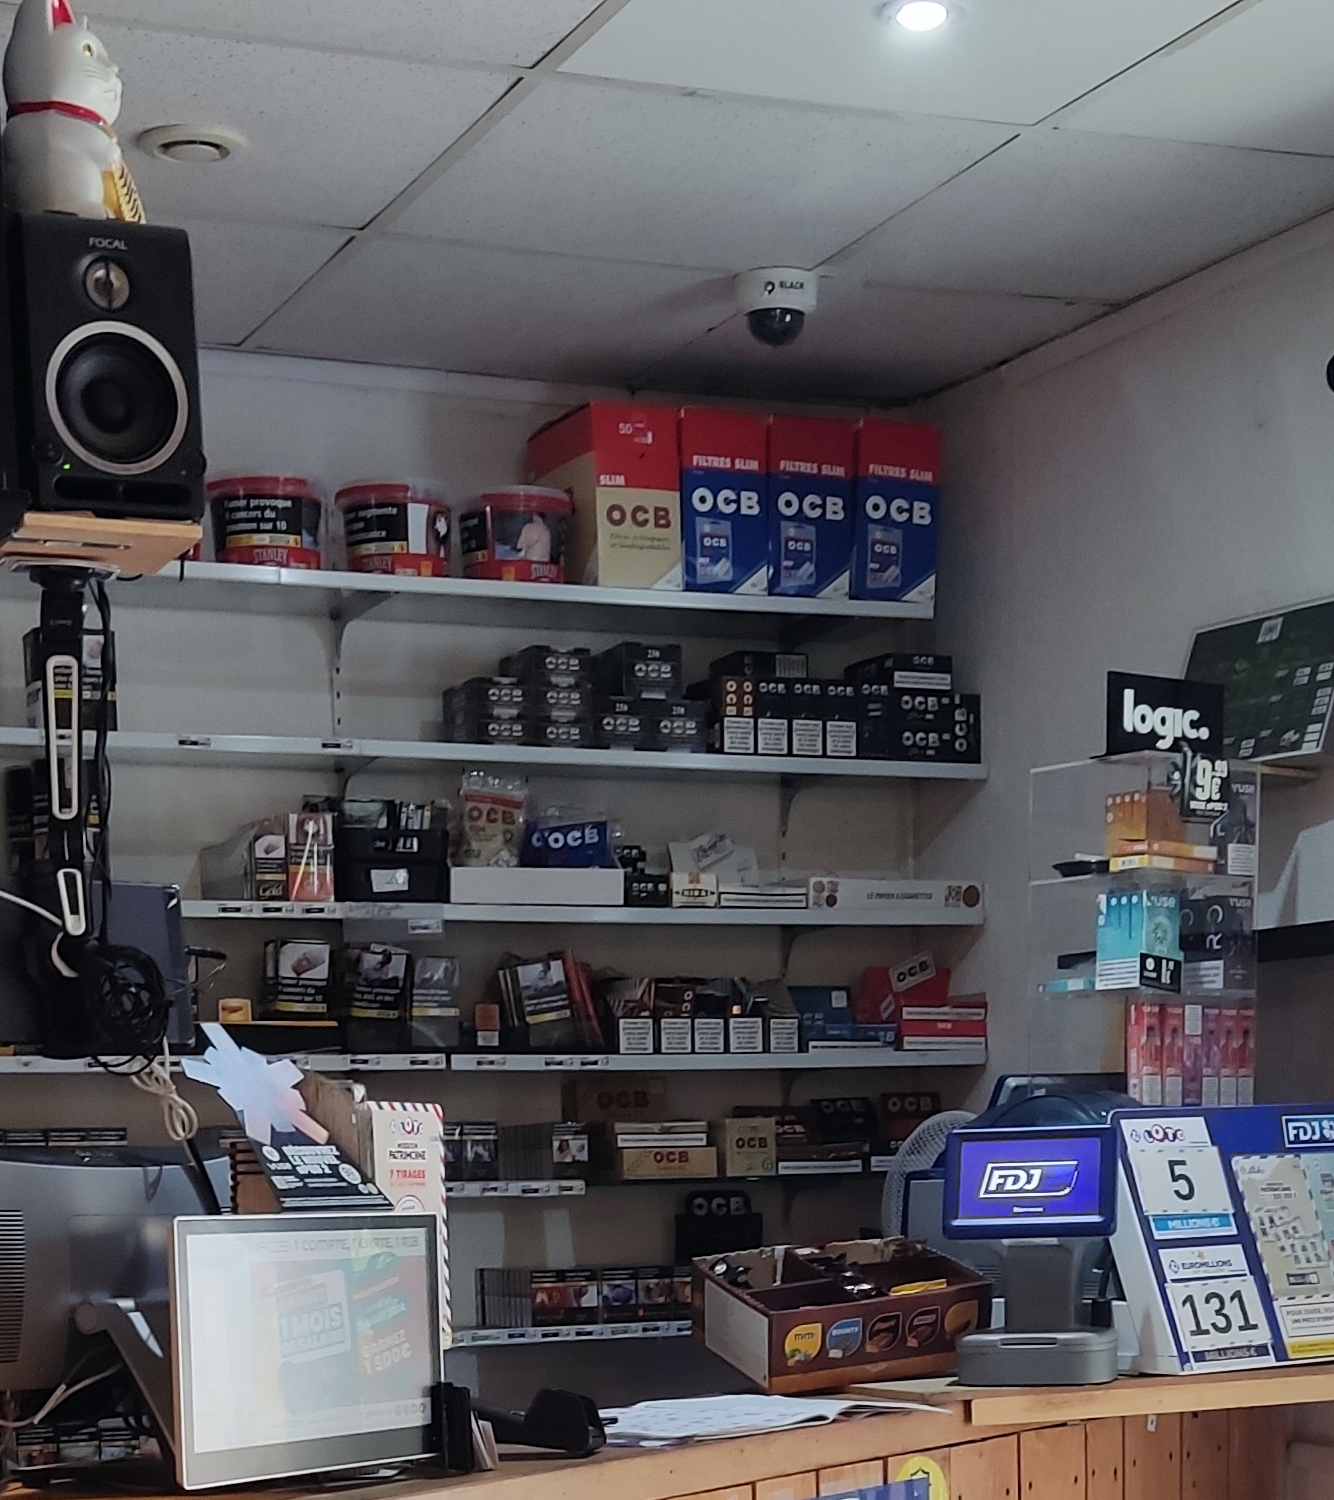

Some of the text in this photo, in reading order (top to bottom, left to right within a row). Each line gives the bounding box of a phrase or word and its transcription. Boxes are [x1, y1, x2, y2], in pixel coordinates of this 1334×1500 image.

[89, 237, 127, 250] FOCAL
[692, 454, 759, 471] FILTRES SLIM
[779, 459, 845, 477] FILTRES SLIM
[868, 463, 933, 481] FILTRES SLIM
[599, 475, 625, 486] SLIM
[691, 486, 761, 515] OCB
[777, 491, 845, 521] OCB
[606, 503, 672, 529] OCB
[865, 494, 933, 525] OCB
[703, 536, 728, 548] OCB
[788, 539, 812, 551] OCB
[874, 543, 898, 555] OCB
[545, 656, 580, 671] OCB
[634, 663, 672, 678] OCB
[488, 688, 523, 701] OCB
[546, 691, 581, 705] OCB
[901, 695, 939, 711] OCB
[488, 723, 523, 737] OCB
[602, 717, 641, 732] OCB
[659, 719, 698, 734] OCB
[546, 726, 581, 740] OCB
[902, 731, 940, 748] OCB
[468, 806, 516, 825] OCB
[548, 824, 600, 849] OCB
[896, 959, 929, 984] OCB
[887, 1096, 933, 1112] OCB
[1144, 1124, 1186, 1143] LOTO
[1287, 1120, 1320, 1142] FDJ
[736, 1136, 768, 1149] OCB
[653, 1150, 690, 1164] OCB
[396, 1169, 426, 1180] TIRAGES
[988, 1168, 1044, 1191] FDJ
[1167, 1159, 1195, 1201] 5
[692, 1196, 746, 1216] OCB
[1181, 1257, 1233, 1271] EUROMILLIONS
[1181, 1289, 1259, 1337] 131
[832, 1326, 859, 1337] BOUNTY
